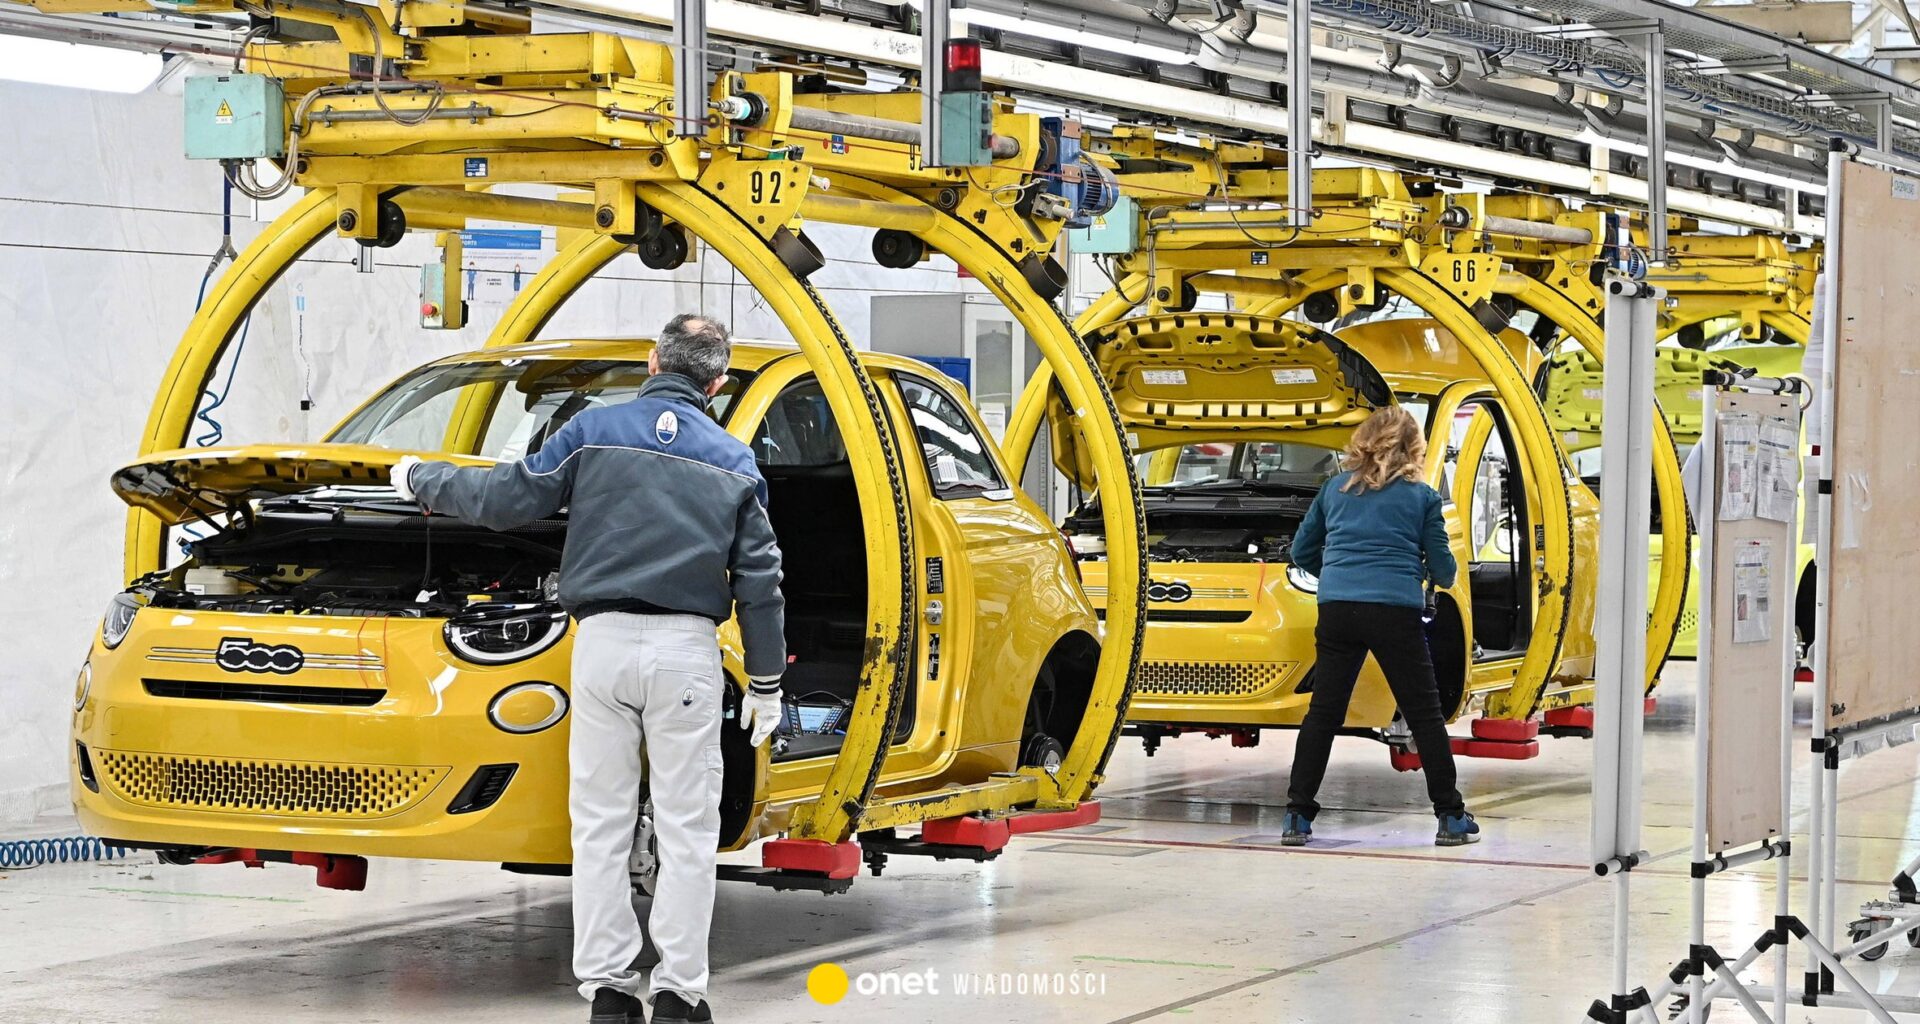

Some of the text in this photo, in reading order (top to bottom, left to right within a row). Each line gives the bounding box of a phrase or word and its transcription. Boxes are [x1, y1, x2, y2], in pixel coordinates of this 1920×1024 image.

[751, 170, 781, 204] 92
[1453, 260, 1475, 282] 66
[1148, 580, 1191, 602] 00
[217, 638, 304, 673] 500
